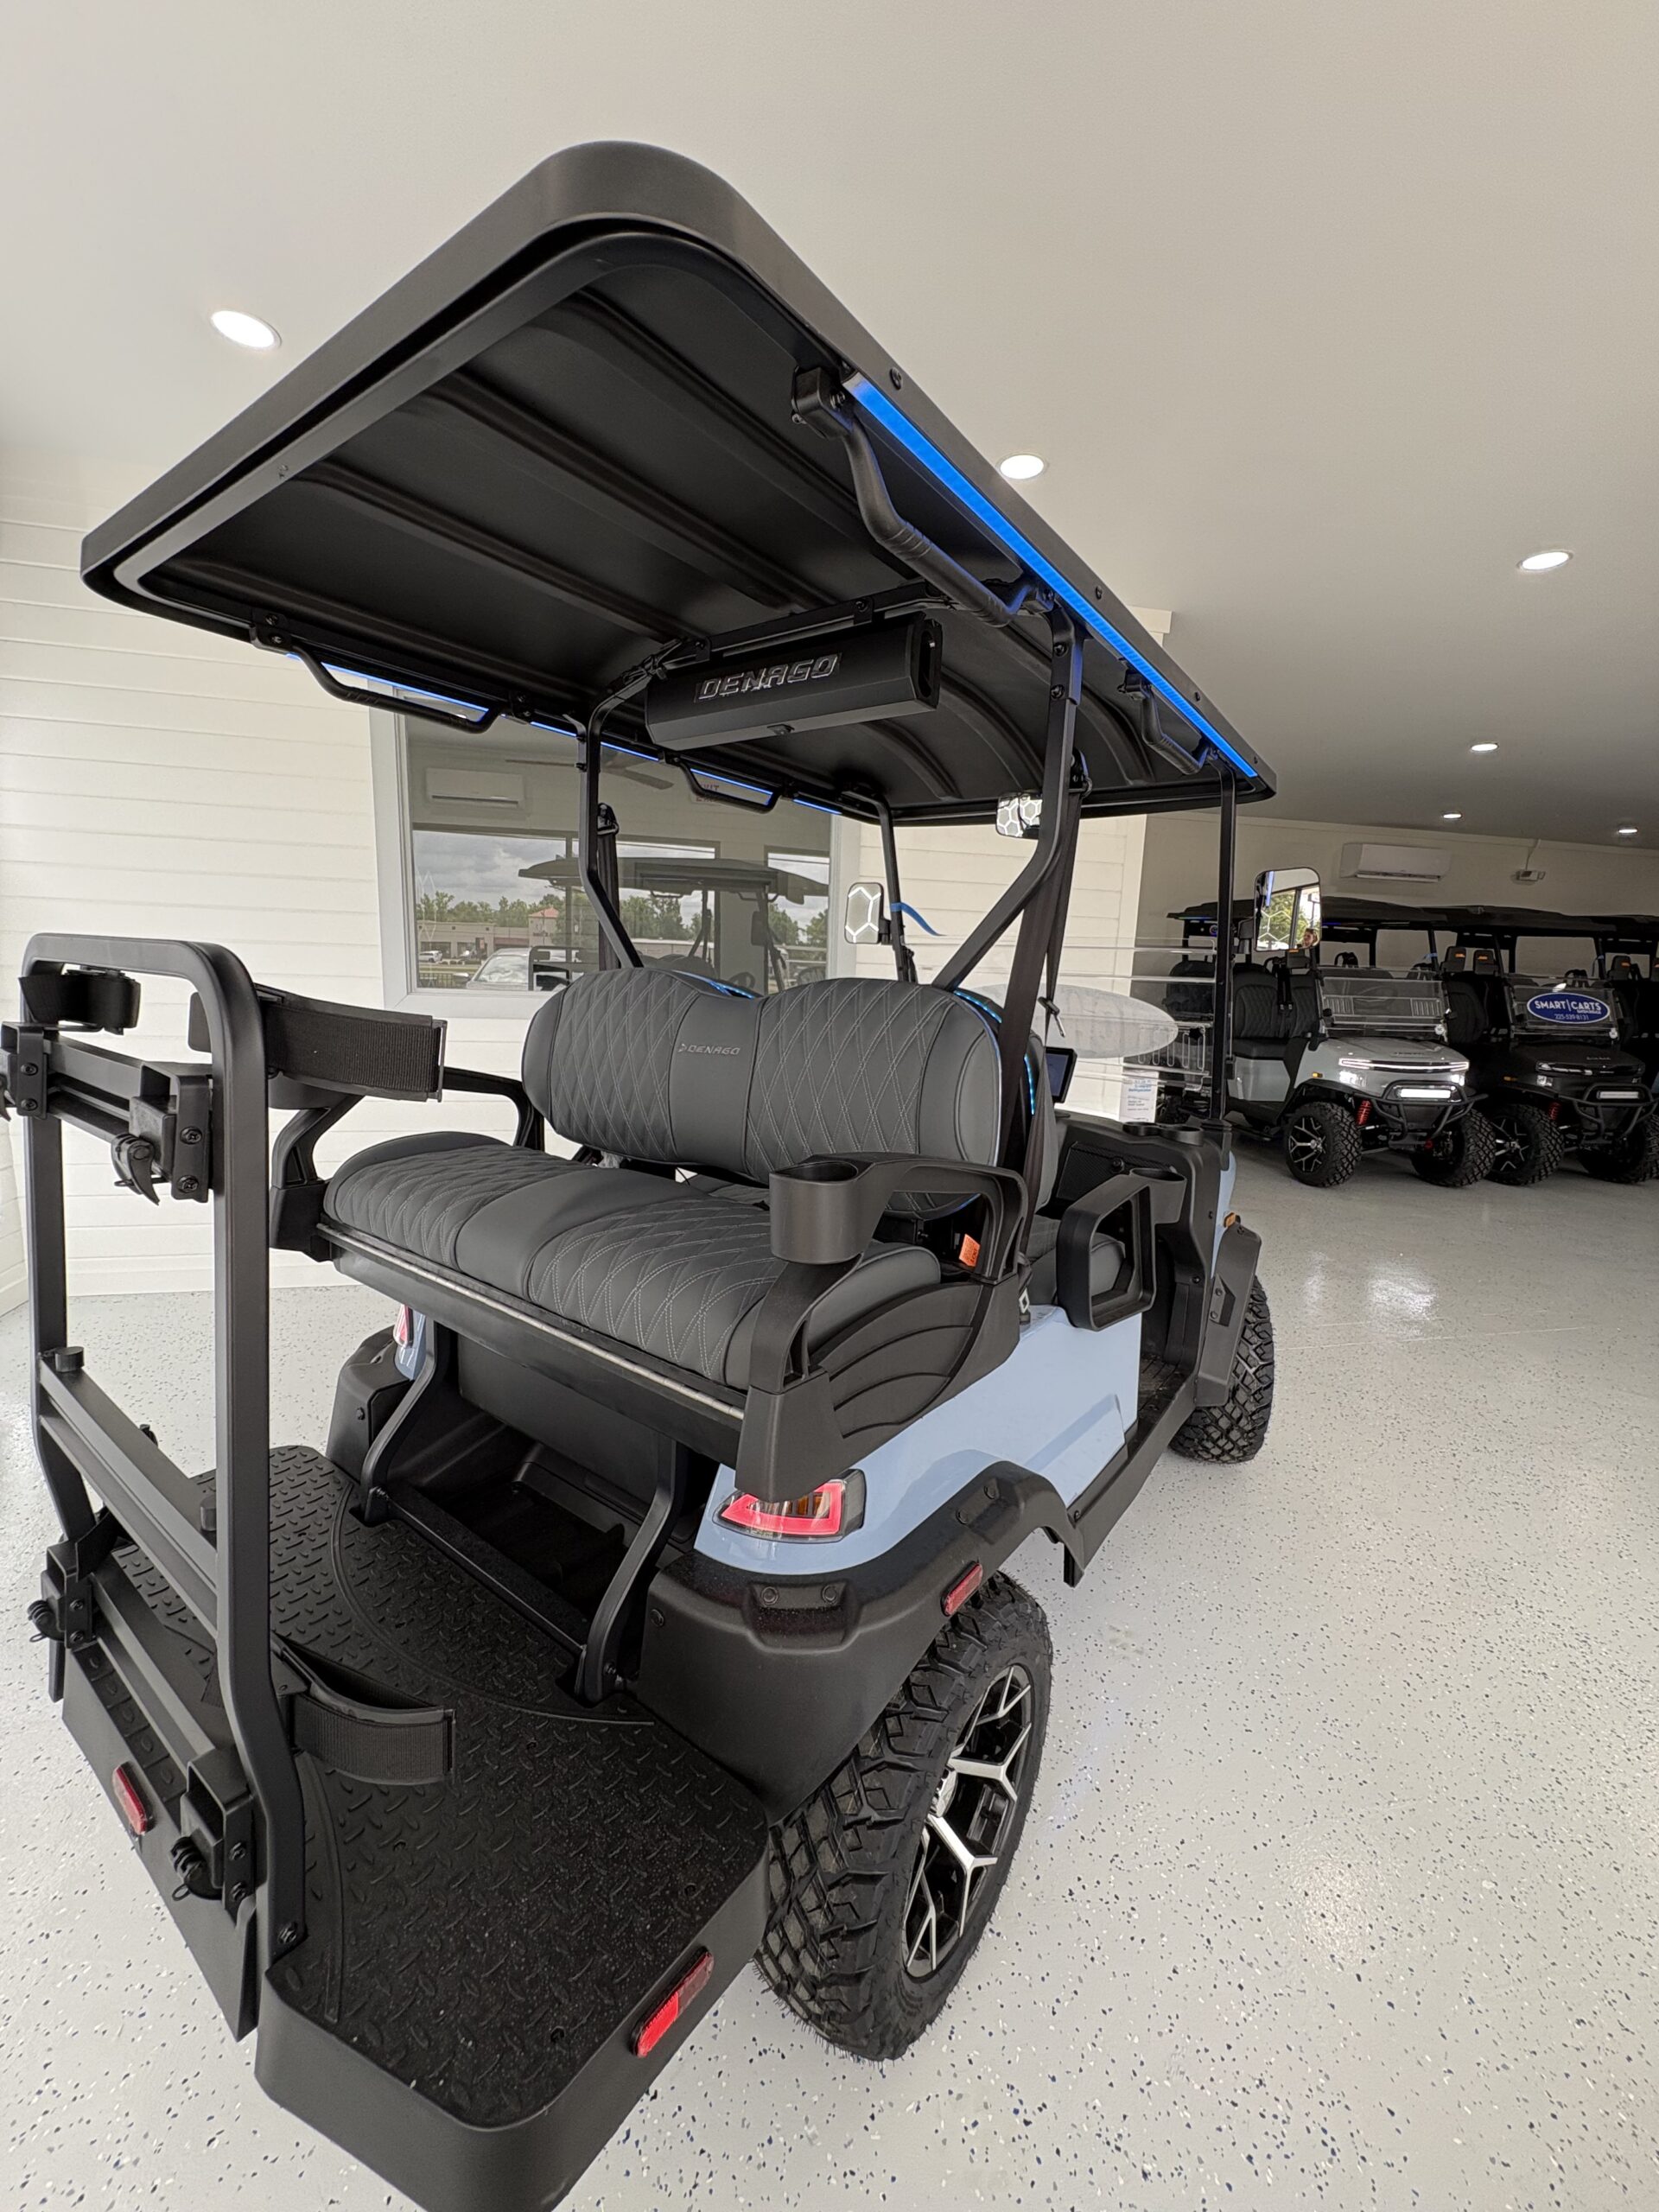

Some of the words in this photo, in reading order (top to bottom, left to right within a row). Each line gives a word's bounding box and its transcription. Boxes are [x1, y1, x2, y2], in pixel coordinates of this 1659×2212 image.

[697, 653, 839, 701] DENAGO
[1535, 1001, 1566, 1009] SMART
[1571, 1001, 1601, 1011] CARTS
[687, 1045, 741, 1055] DENAGO
